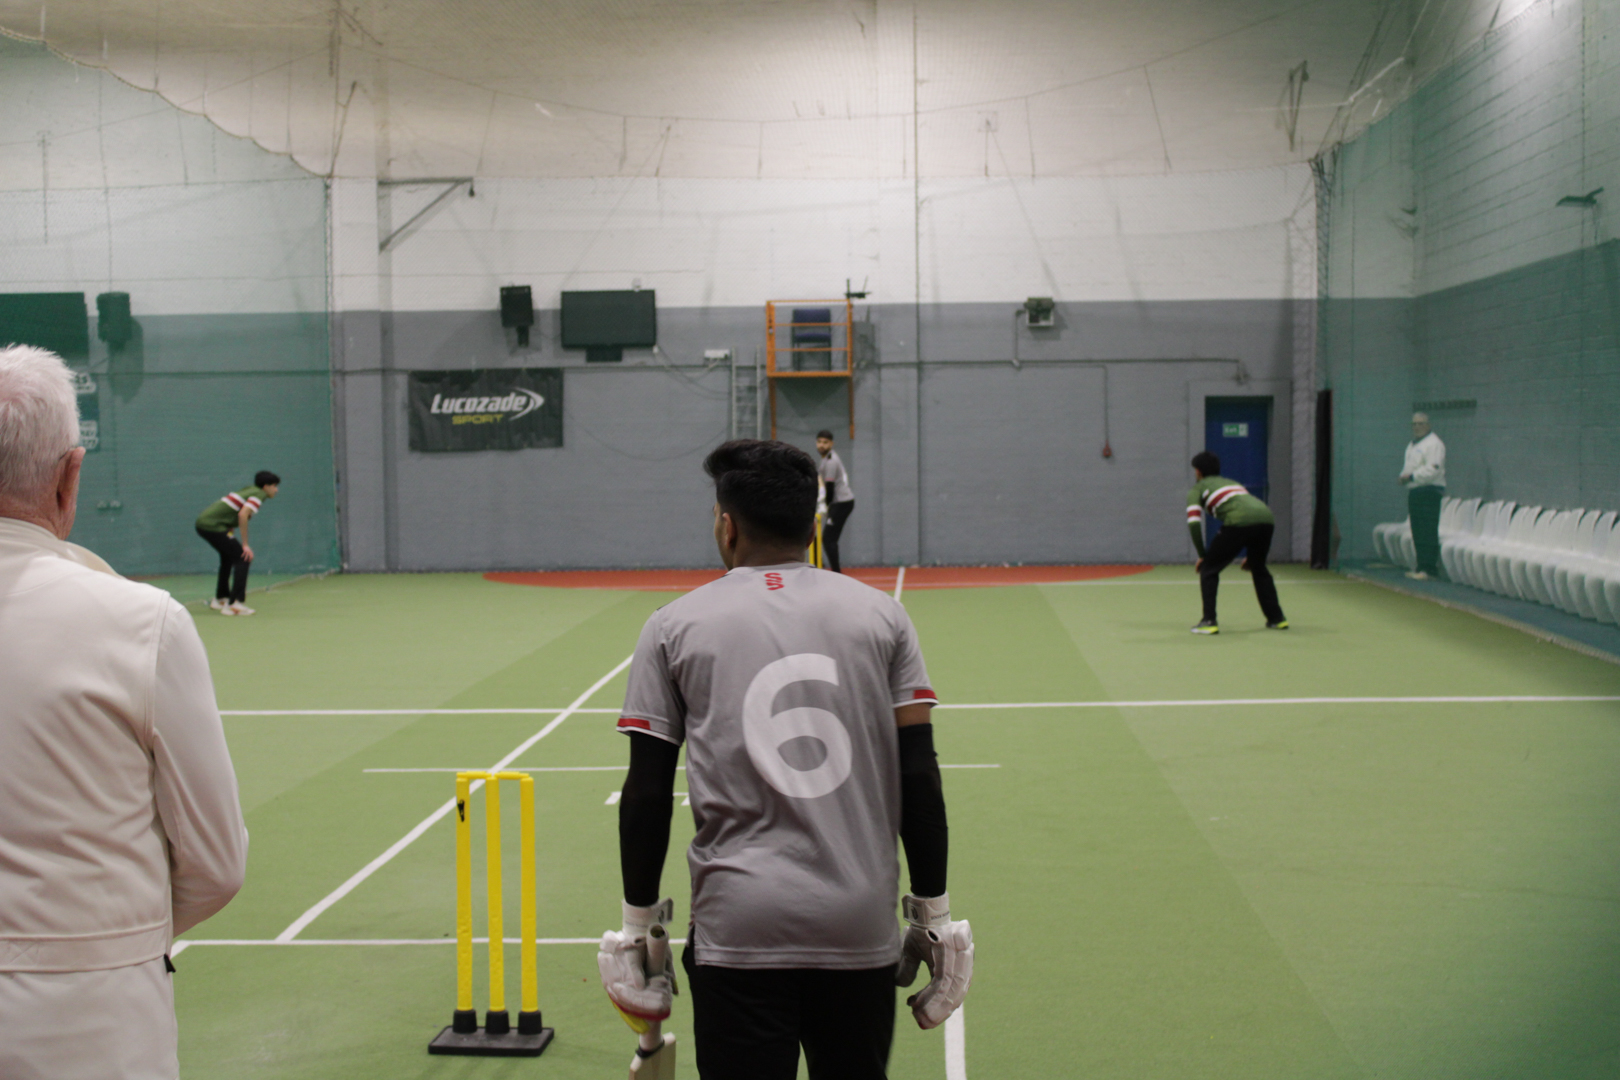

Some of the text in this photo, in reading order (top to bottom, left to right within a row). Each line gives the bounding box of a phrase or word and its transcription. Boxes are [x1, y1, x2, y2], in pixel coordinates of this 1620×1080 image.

[430, 392, 527, 414] Lucozade
[452, 414, 504, 425] SPORT
[742, 653, 852, 799] 6
